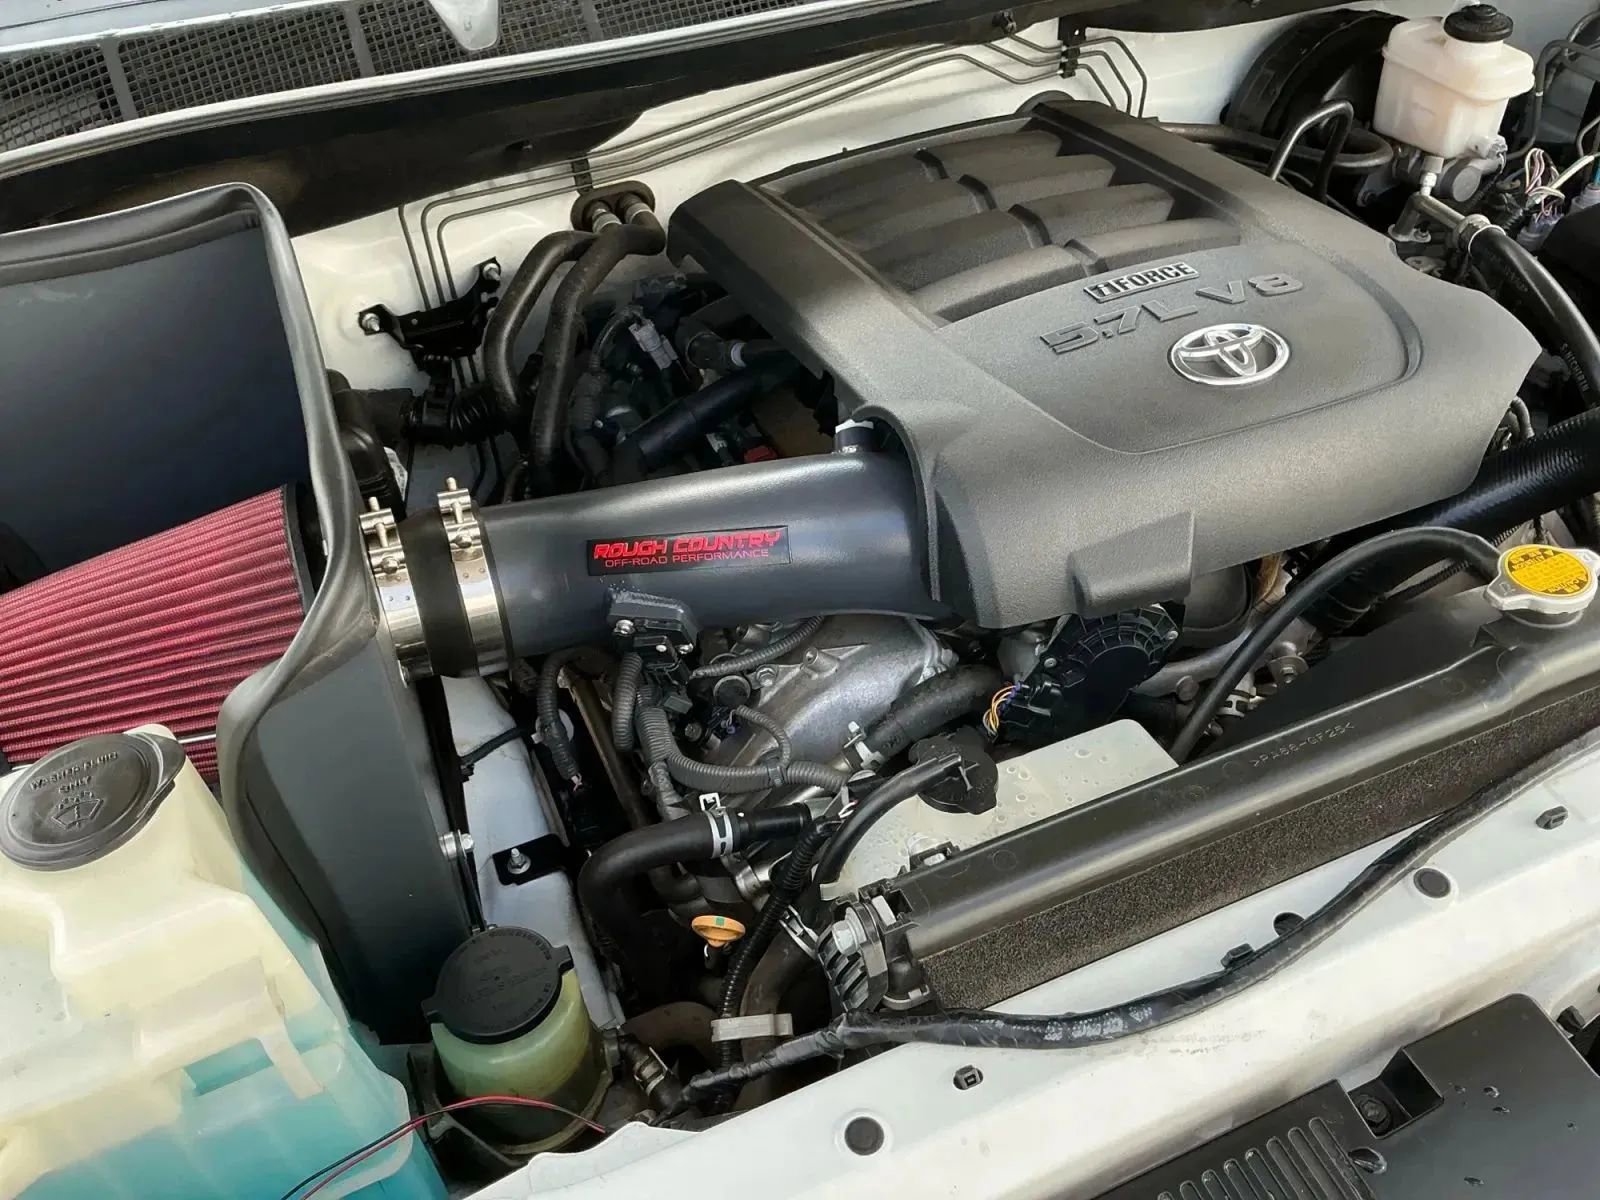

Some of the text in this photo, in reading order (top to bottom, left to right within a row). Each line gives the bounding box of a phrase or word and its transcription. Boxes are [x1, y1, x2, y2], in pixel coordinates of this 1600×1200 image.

[1195, 272, 1303, 304] V8
[593, 530, 781, 560] ROUGH COUNTRY
[604, 548, 769, 568] OFF-ROAD PERFORMANCE
